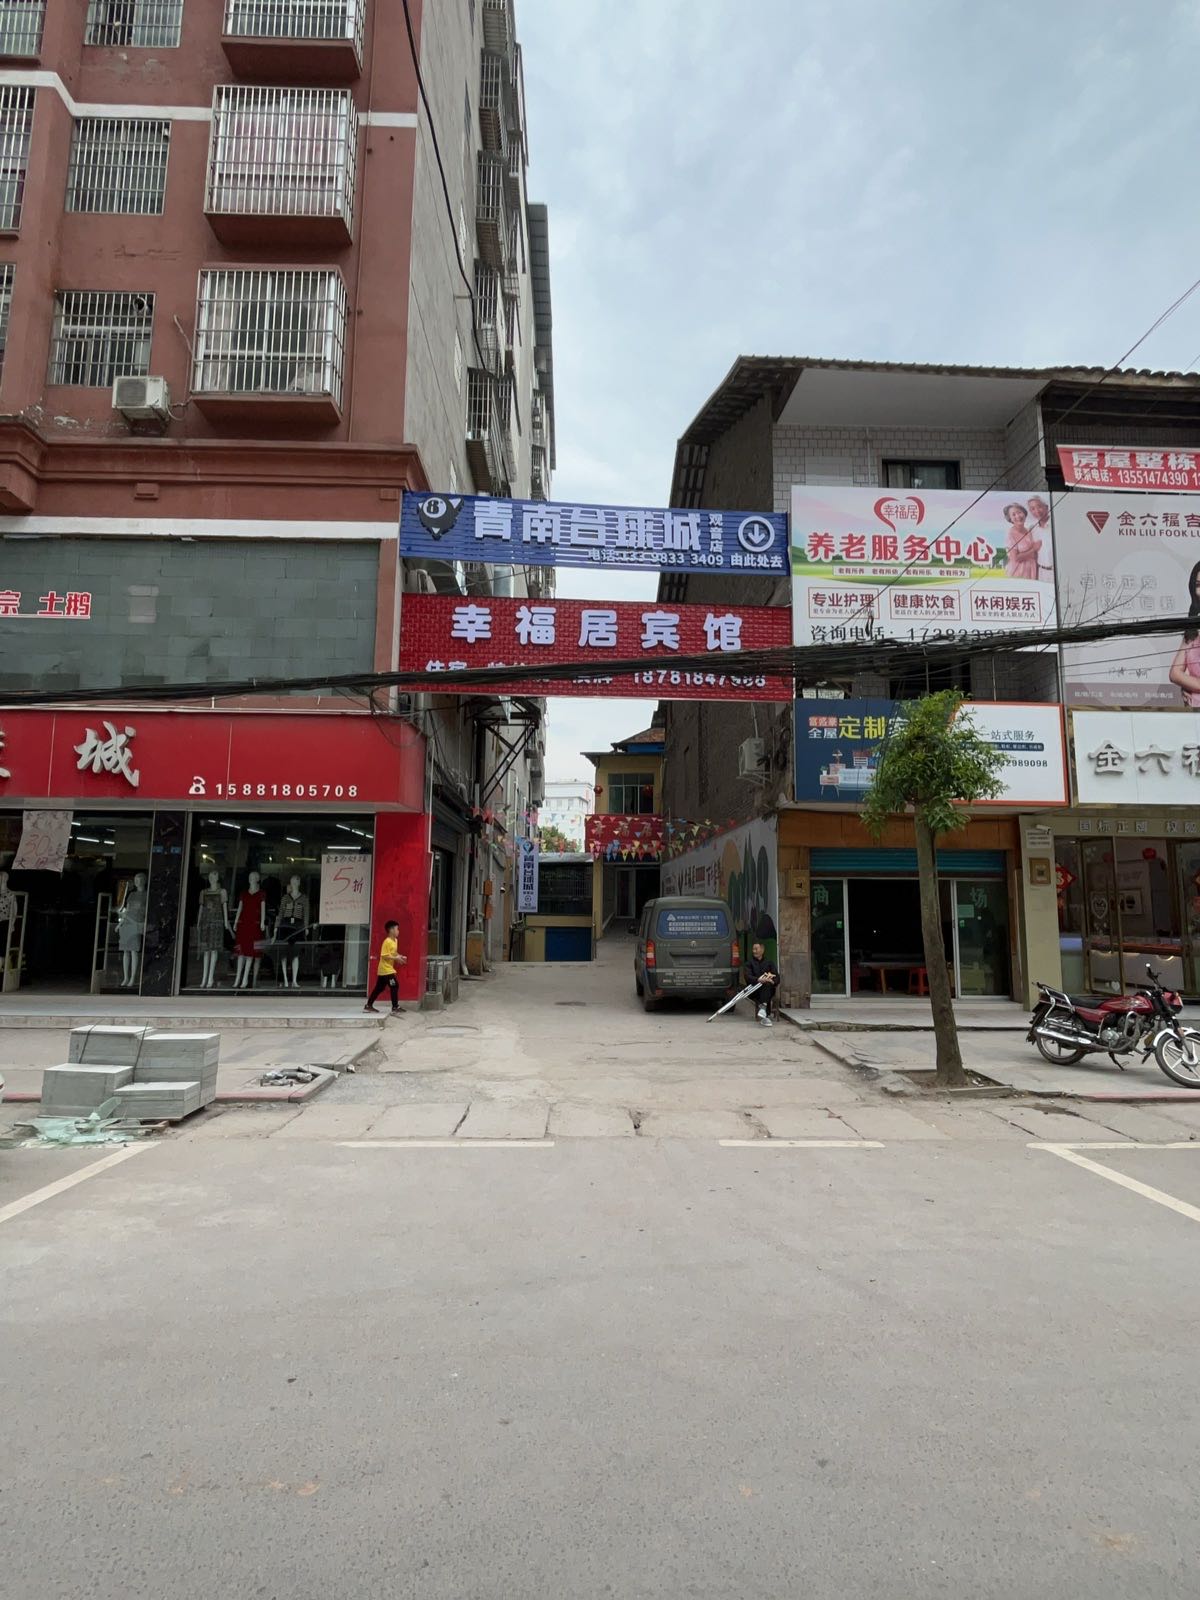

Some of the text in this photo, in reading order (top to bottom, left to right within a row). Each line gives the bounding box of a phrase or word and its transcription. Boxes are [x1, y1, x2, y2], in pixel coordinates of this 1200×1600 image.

[1072, 451, 1197, 470] 房屋整栋
[1118, 469, 1189, 486] 13551474390
[883, 503, 918, 520] 幸福居
[474, 500, 702, 552] 青南台球城
[709, 513, 724, 553] 观音店
[1118, 528, 1137, 536] KIN
[1139, 528, 1156, 536] LIU
[1160, 528, 1189, 537] FOOK
[807, 532, 994, 564] 养老服务中心
[690, 553, 724, 566] 3409
[730, 553, 783, 568] 由此处去
[812, 592, 875, 608] 专业护理
[893, 593, 956, 609] 健康饮食
[974, 595, 1036, 611] 休闲娱乐
[451, 604, 743, 651] 幸福居宾馆
[808, 727, 838, 739] 全屋
[215, 783, 358, 798] 15881805708
[813, 885, 829, 906] 商
[970, 887, 988, 908] 场
